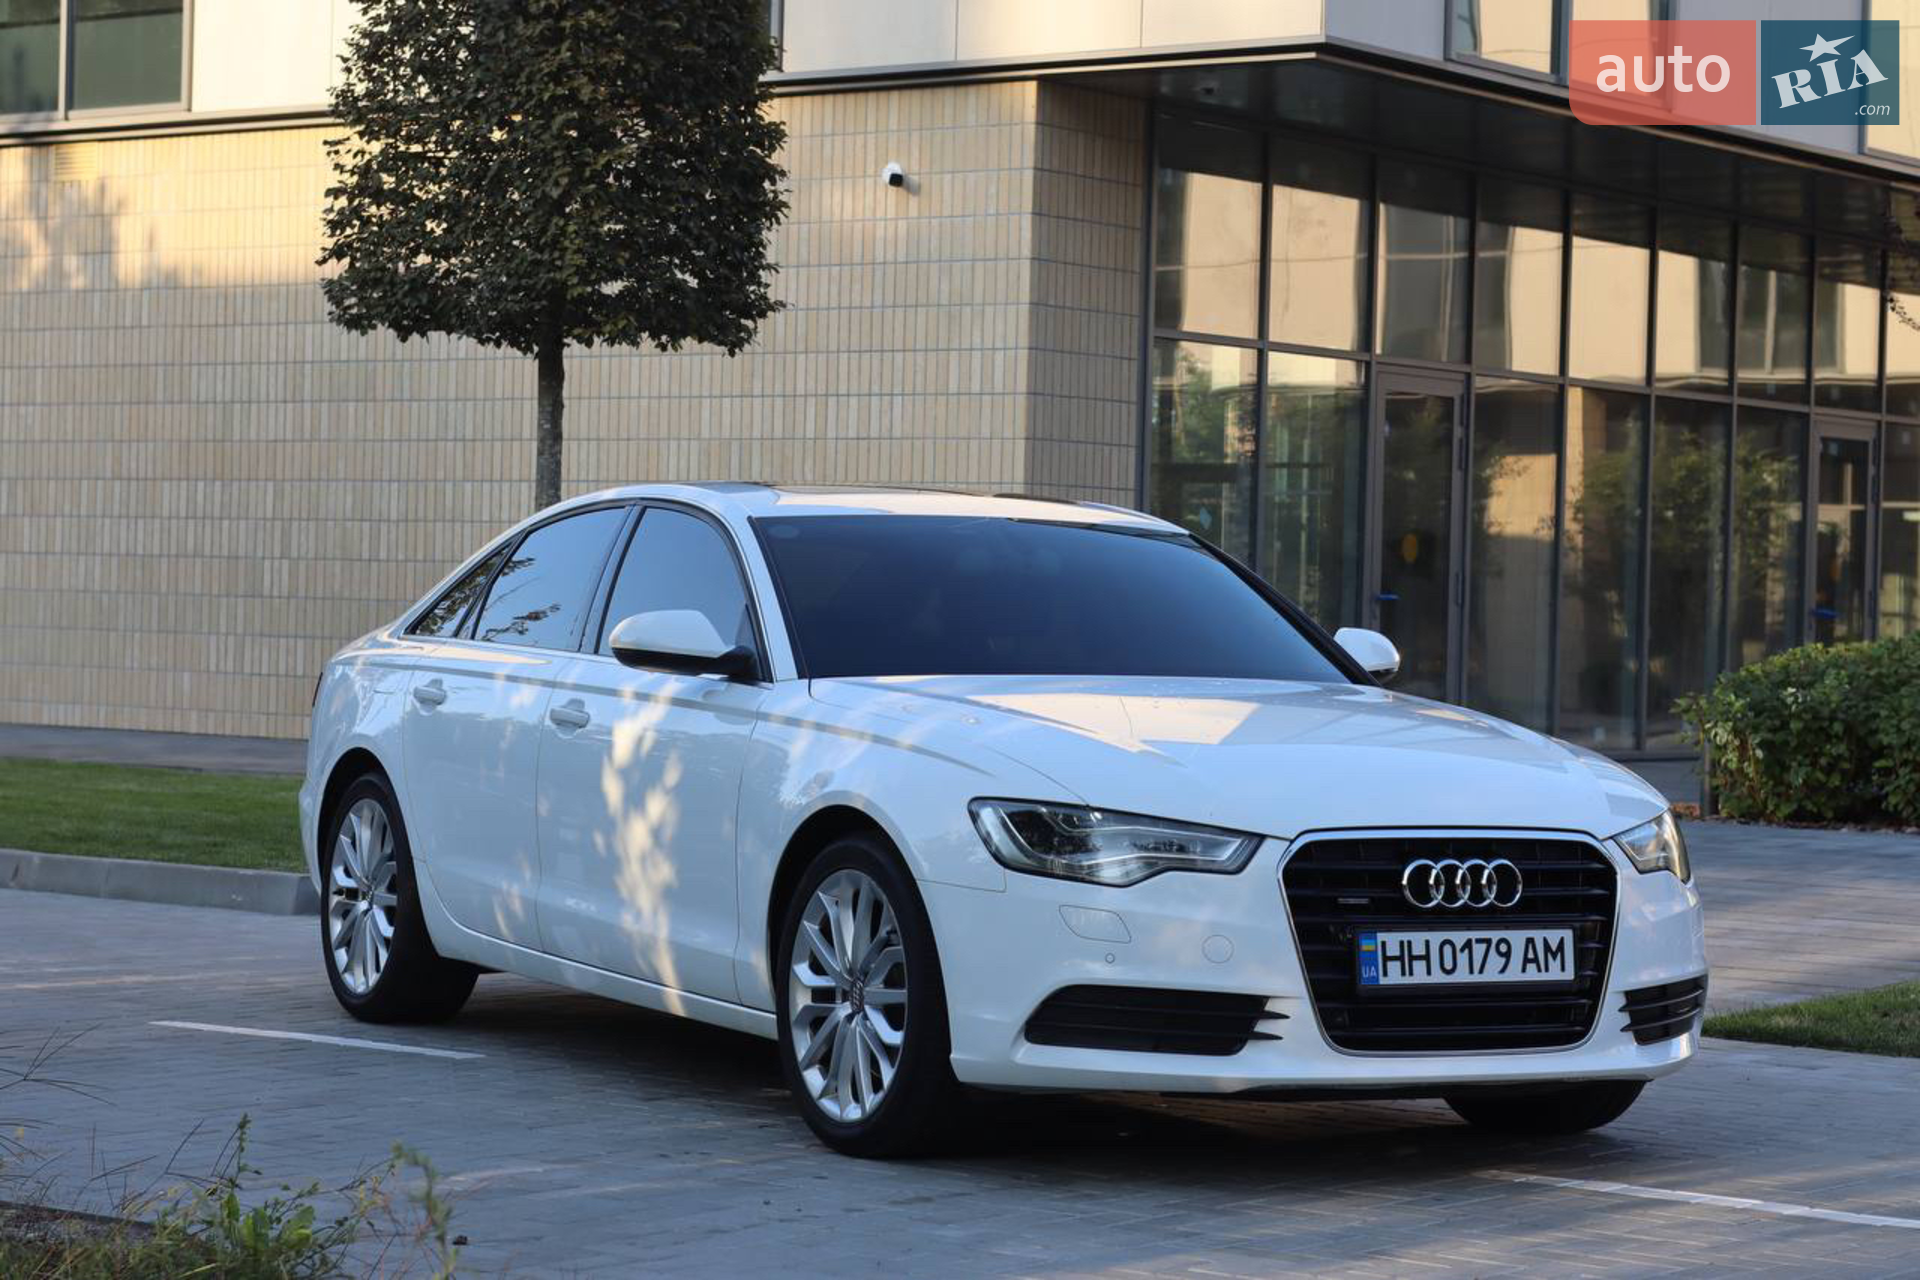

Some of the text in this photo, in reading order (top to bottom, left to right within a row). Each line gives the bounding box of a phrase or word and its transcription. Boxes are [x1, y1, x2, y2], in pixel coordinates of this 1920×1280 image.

[1380, 936, 1566, 977] HH 0179 AM
[1361, 965, 1377, 979] UA
